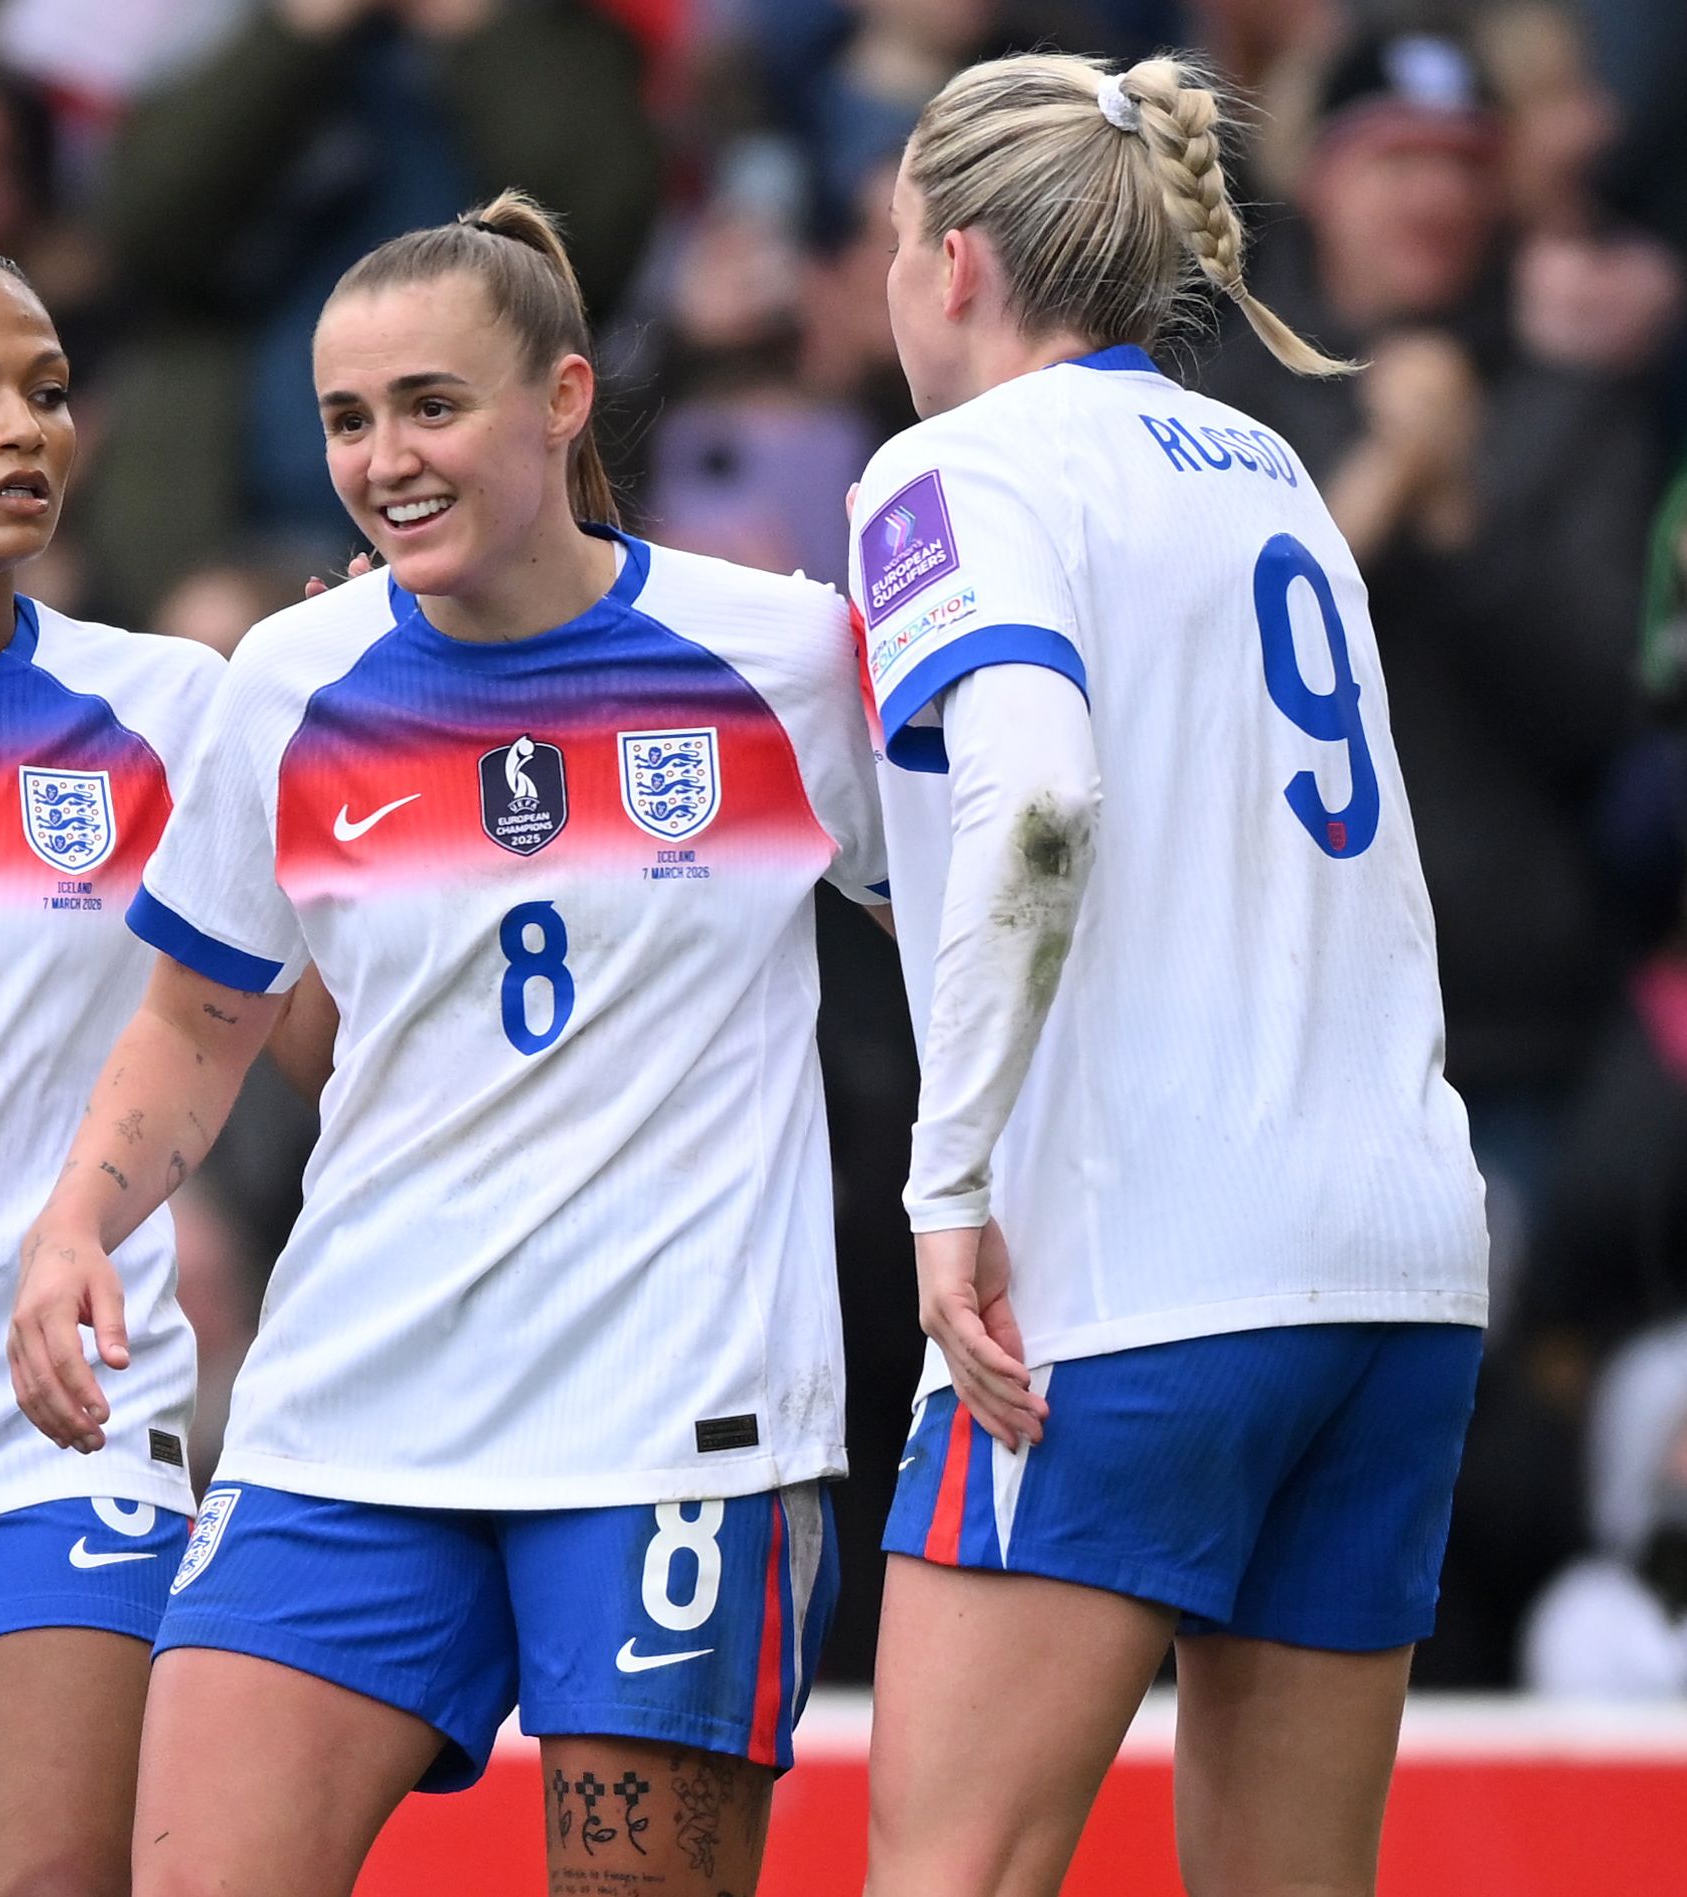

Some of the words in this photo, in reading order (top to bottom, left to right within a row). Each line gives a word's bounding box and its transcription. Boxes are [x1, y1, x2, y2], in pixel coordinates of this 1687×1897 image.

[1138, 414, 1298, 488] RUSSO
[872, 538, 944, 597] EUROPEAN
[873, 549, 947, 609] QUALIFIERS
[872, 591, 976, 678] FOUNDATION
[1253, 532, 1380, 859] 9
[496, 821, 554, 835] CHAMPIONS
[498, 811, 550, 826] EUROPEAN
[511, 833, 542, 846] 2025
[657, 850, 695, 863] ICELAND
[58, 881, 93, 894] ICELAND
[642, 867, 649, 880] 7
[651, 867, 683, 879] MARCH
[685, 866, 710, 879] 2026
[43, 897, 49, 909] 7
[52, 897, 81, 909] MARCH
[82, 898, 102, 910] 2026
[500, 900, 575, 1056] 8
[642, 1499, 725, 1631] 8
